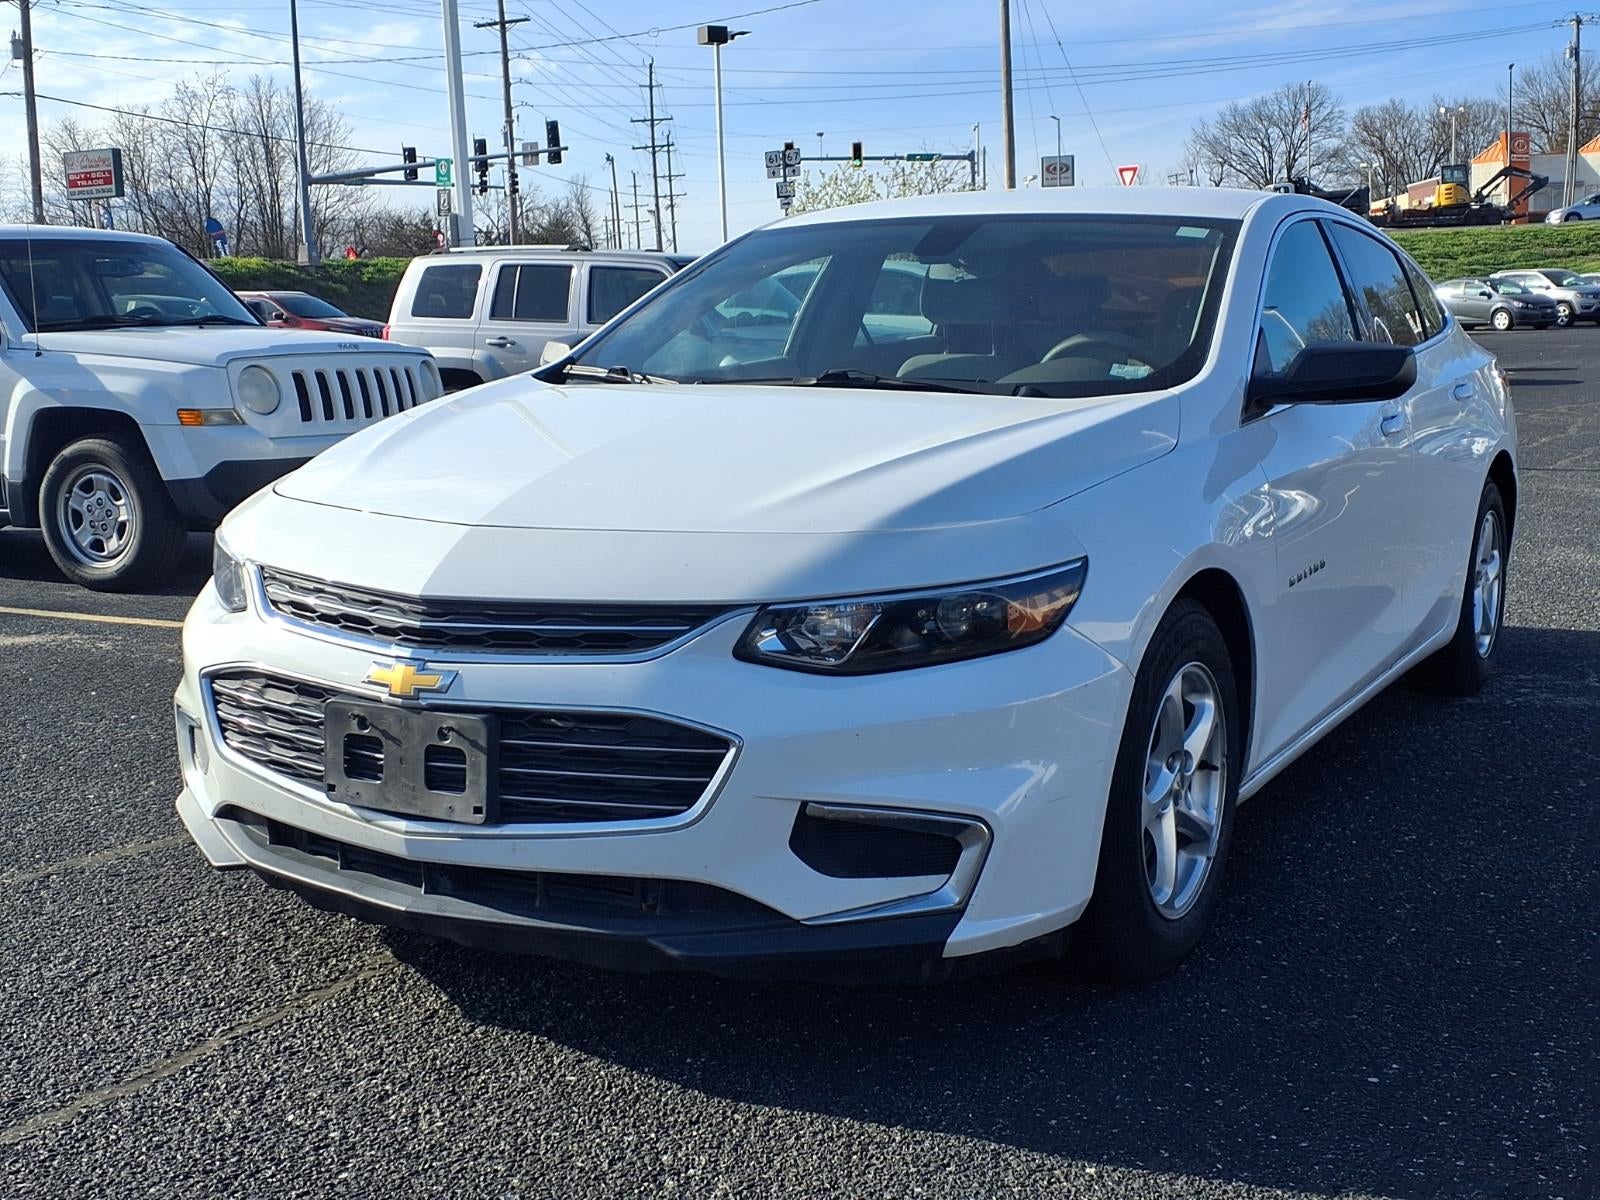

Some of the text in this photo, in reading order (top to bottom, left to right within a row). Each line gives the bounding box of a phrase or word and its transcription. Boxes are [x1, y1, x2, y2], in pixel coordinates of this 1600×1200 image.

[769, 155, 778, 164] 61
[786, 151, 799, 161] 67
[76, 178, 104, 186] TRADE
